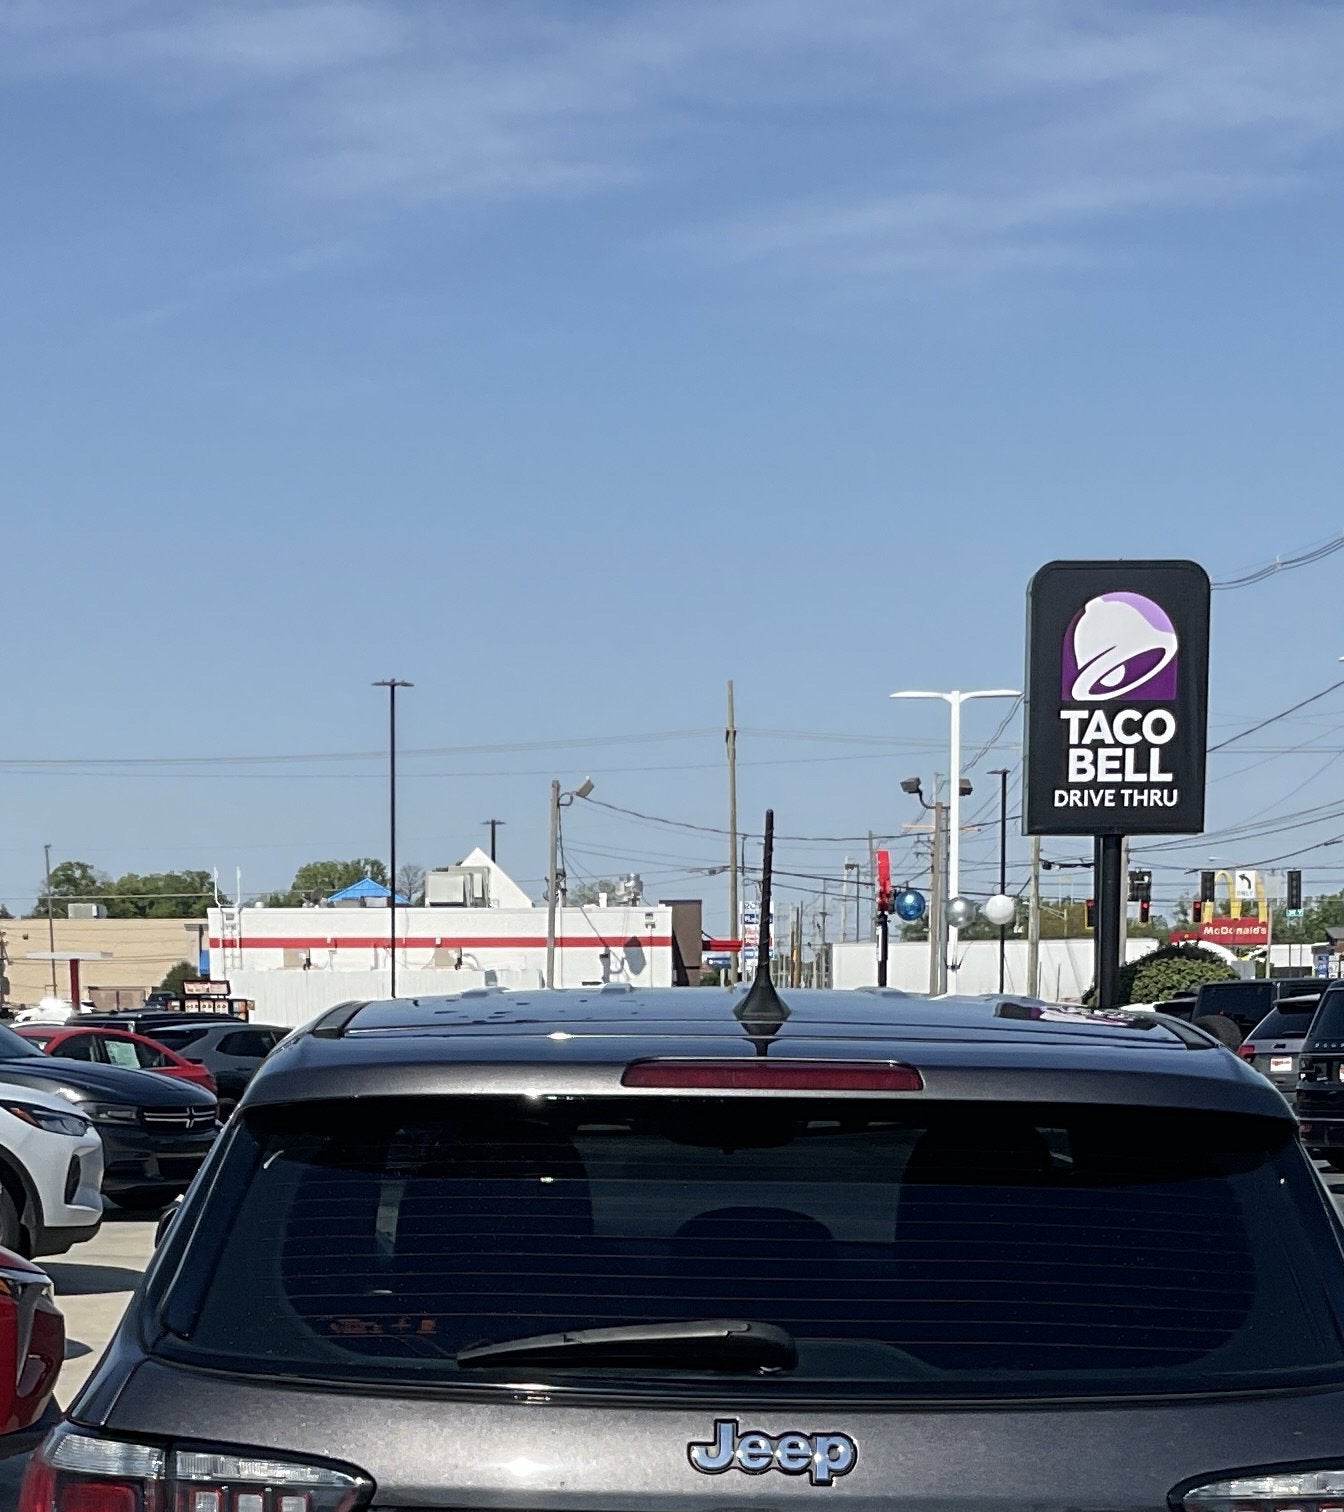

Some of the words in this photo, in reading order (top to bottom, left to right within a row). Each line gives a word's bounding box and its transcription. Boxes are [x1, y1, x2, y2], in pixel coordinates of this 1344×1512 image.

[1060, 709, 1176, 745] TACO
[1068, 748, 1173, 782] BELL
[1054, 789, 1116, 807] DRIVE
[1120, 789, 1178, 807] THRU
[688, 1419, 858, 1485] Jeep
